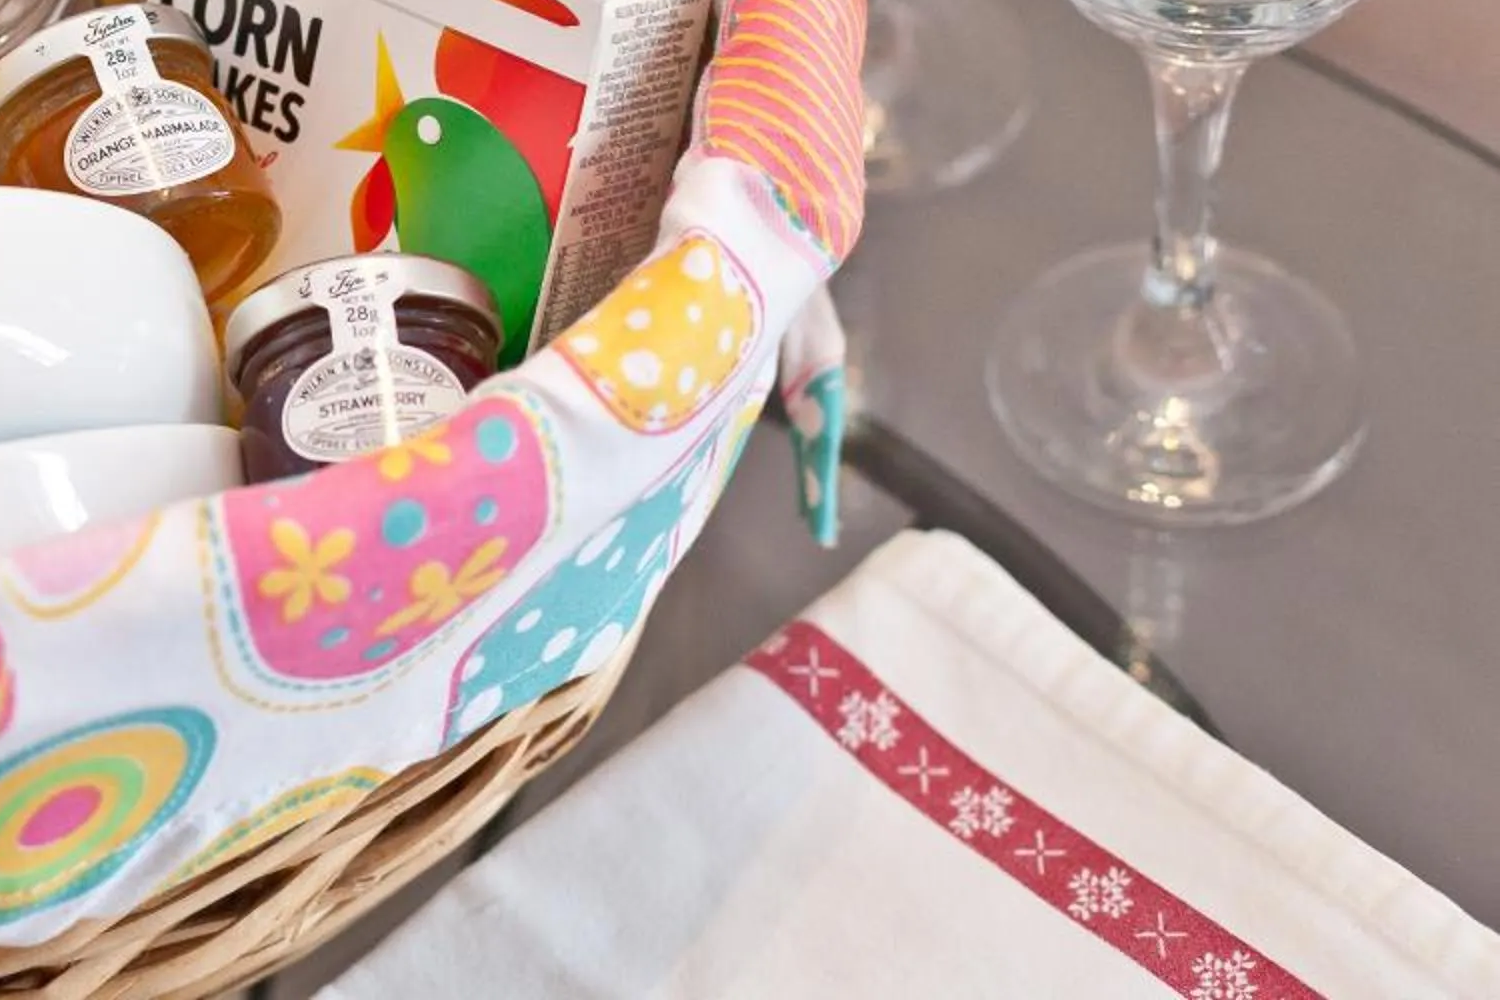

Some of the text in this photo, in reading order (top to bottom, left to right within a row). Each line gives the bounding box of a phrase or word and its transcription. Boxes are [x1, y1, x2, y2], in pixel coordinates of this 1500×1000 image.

[105, 49, 138, 67] 28g
[213, 58, 306, 144] KES
[78, 107, 113, 144] WILKIN
[77, 119, 224, 172] ORANGE MARMALADE
[300, 367, 336, 400] WILKIN
[319, 391, 427, 419] STRAWRRY
